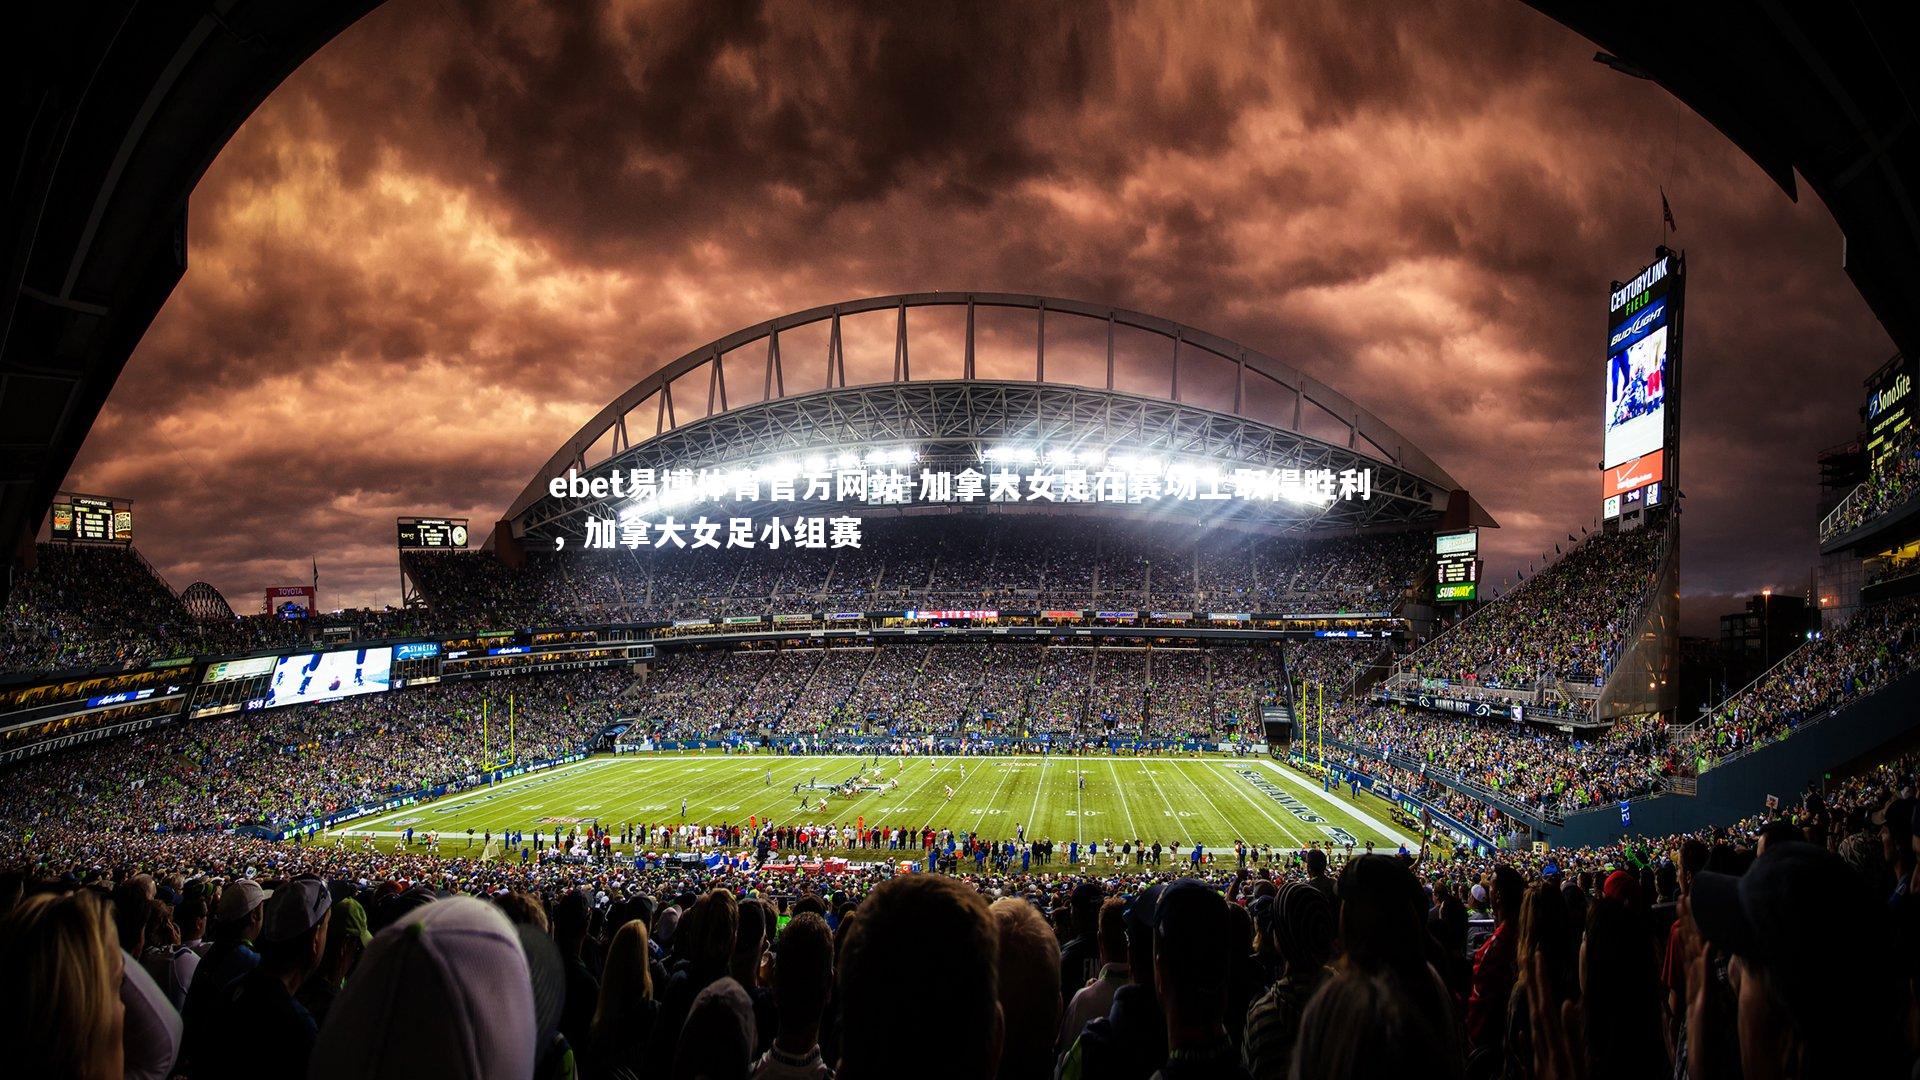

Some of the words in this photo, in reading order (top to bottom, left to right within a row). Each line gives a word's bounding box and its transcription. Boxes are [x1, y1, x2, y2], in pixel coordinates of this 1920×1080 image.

[1611, 256, 1668, 313] CENTURYLINK
[1626, 290, 1650, 316] FIELD
[1611, 327, 1632, 347] BUD
[1632, 306, 1664, 334] LIGHT
[1877, 373, 1911, 414] SonoSite
[1873, 407, 1905, 434] DEFENSE
[1437, 585, 1474, 599] SUBWAY
[490, 668, 516, 677] HOME
[589, 660, 609, 668] MAN
[9, 749, 24, 762] TO
[30, 728, 112, 756] CENTURYLINK
[118, 720, 153, 734] FIELD
[1620, 805, 1630, 822] 12
